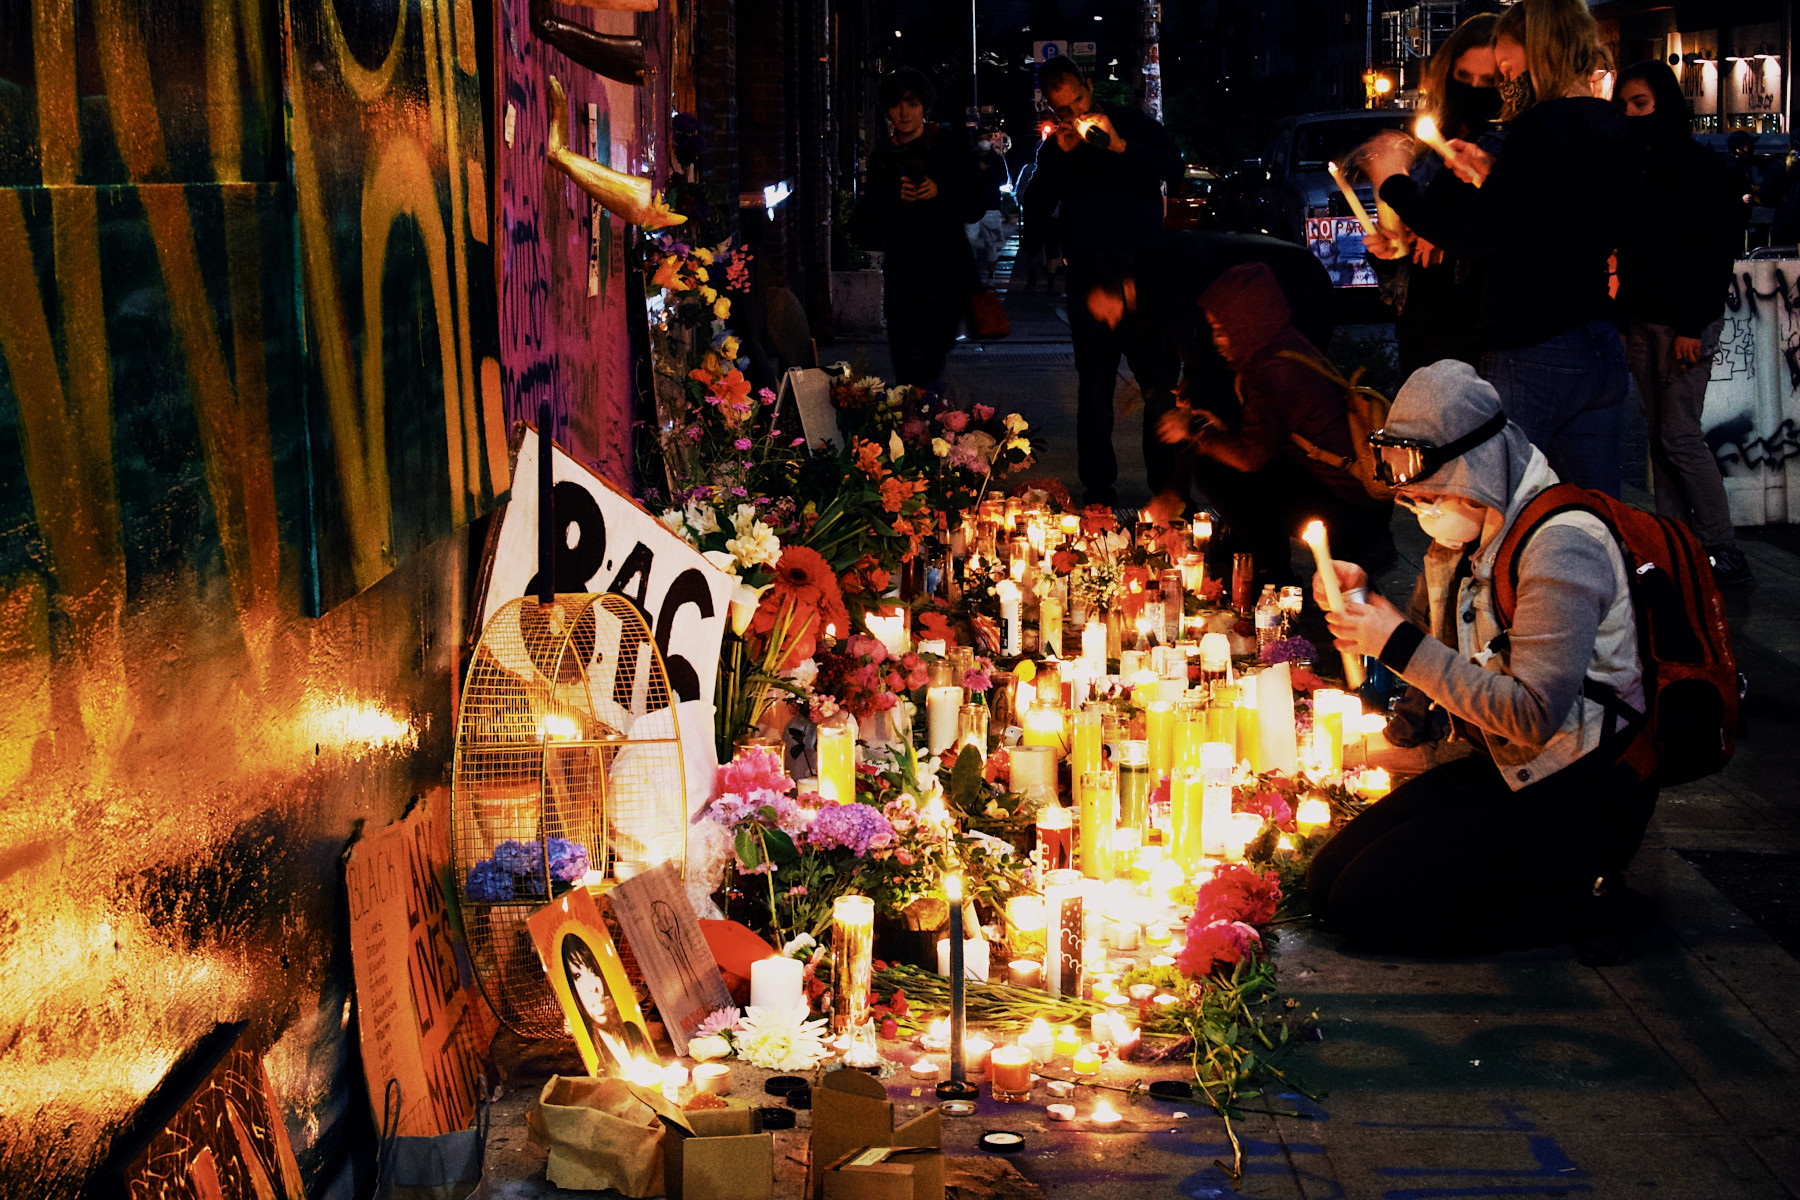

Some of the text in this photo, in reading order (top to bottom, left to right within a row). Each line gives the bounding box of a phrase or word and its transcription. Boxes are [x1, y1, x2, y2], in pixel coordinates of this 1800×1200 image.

[1308, 220, 1331, 238] NO
[348, 849, 398, 922] BLACK
[408, 909, 461, 1037] LIVES
